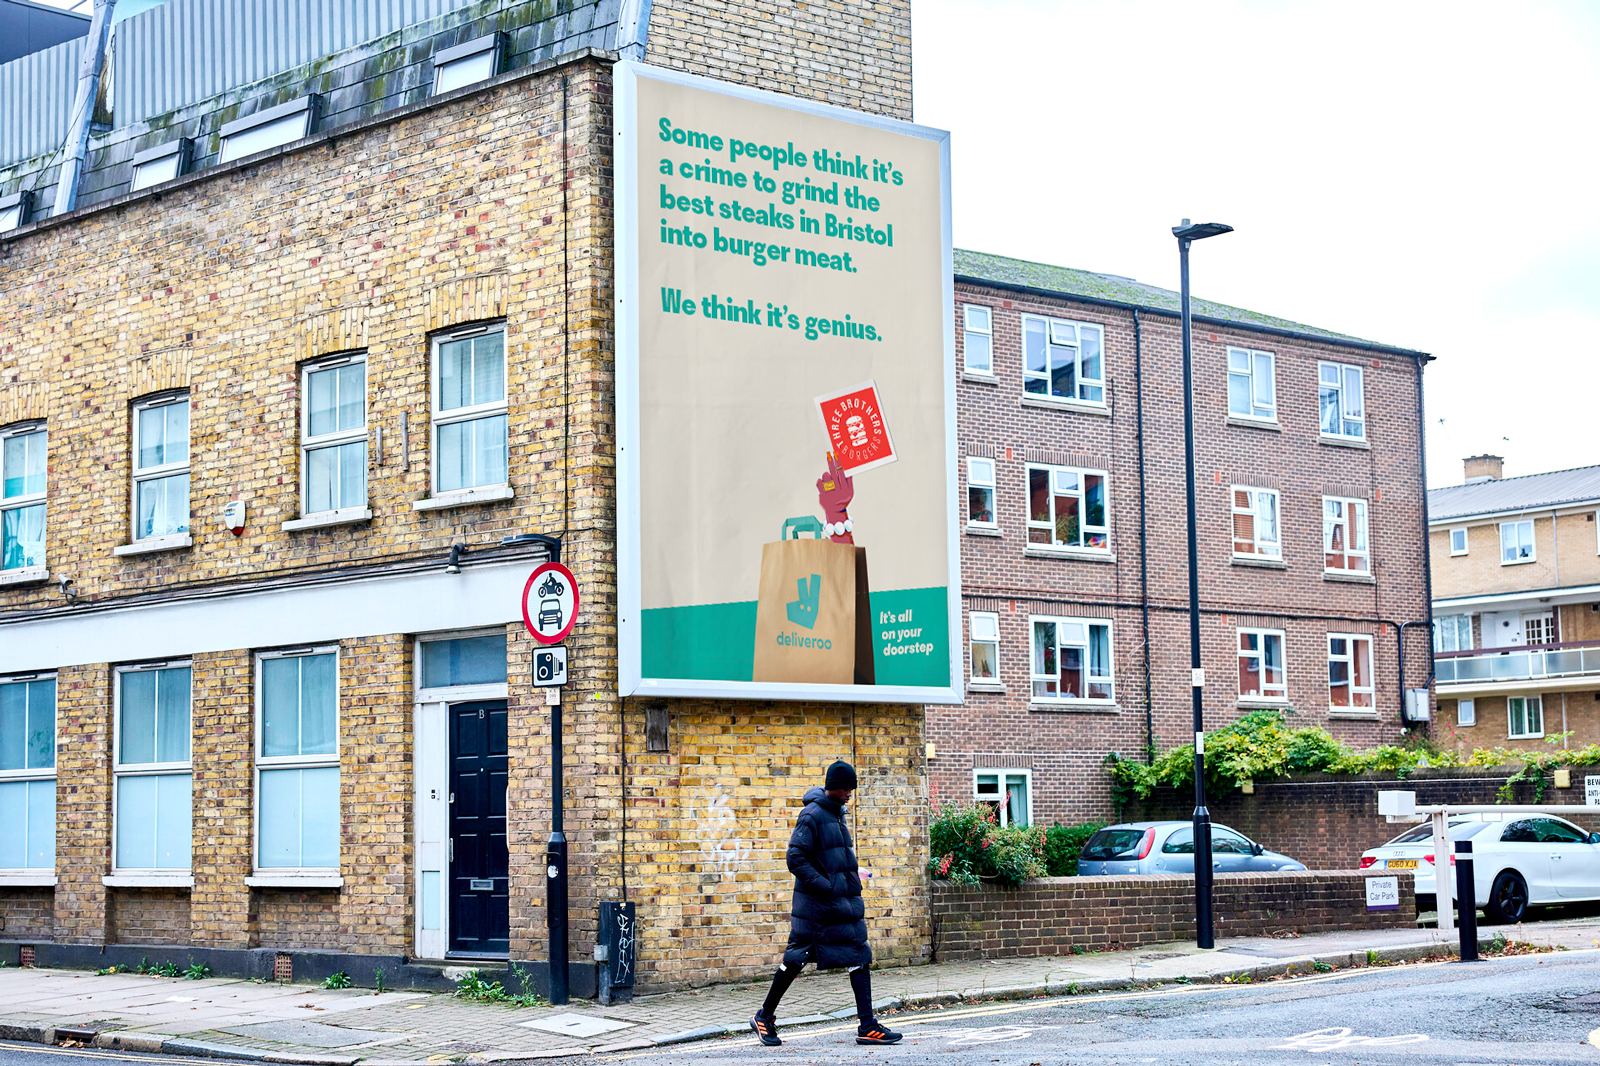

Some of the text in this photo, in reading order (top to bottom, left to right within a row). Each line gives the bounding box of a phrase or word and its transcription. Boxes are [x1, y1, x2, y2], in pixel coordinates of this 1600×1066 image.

[659, 118, 903, 185] Some people think it's
[660, 158, 880, 212] a crime to grind the
[660, 184, 893, 247] best steaks in Bristol
[661, 218, 857, 273] into burger meat.
[661, 287, 882, 341] We think it's genius.
[831, 398, 882, 449] THREE BROTHERS
[880, 609, 912, 624] It's all
[776, 631, 832, 650] deliveroo
[882, 628, 922, 643] on your
[883, 642, 934, 656] doorstep
[478, 709, 485, 719] B
[1371, 880, 1392, 889] Private
[1370, 891, 1395, 901] Car Park
